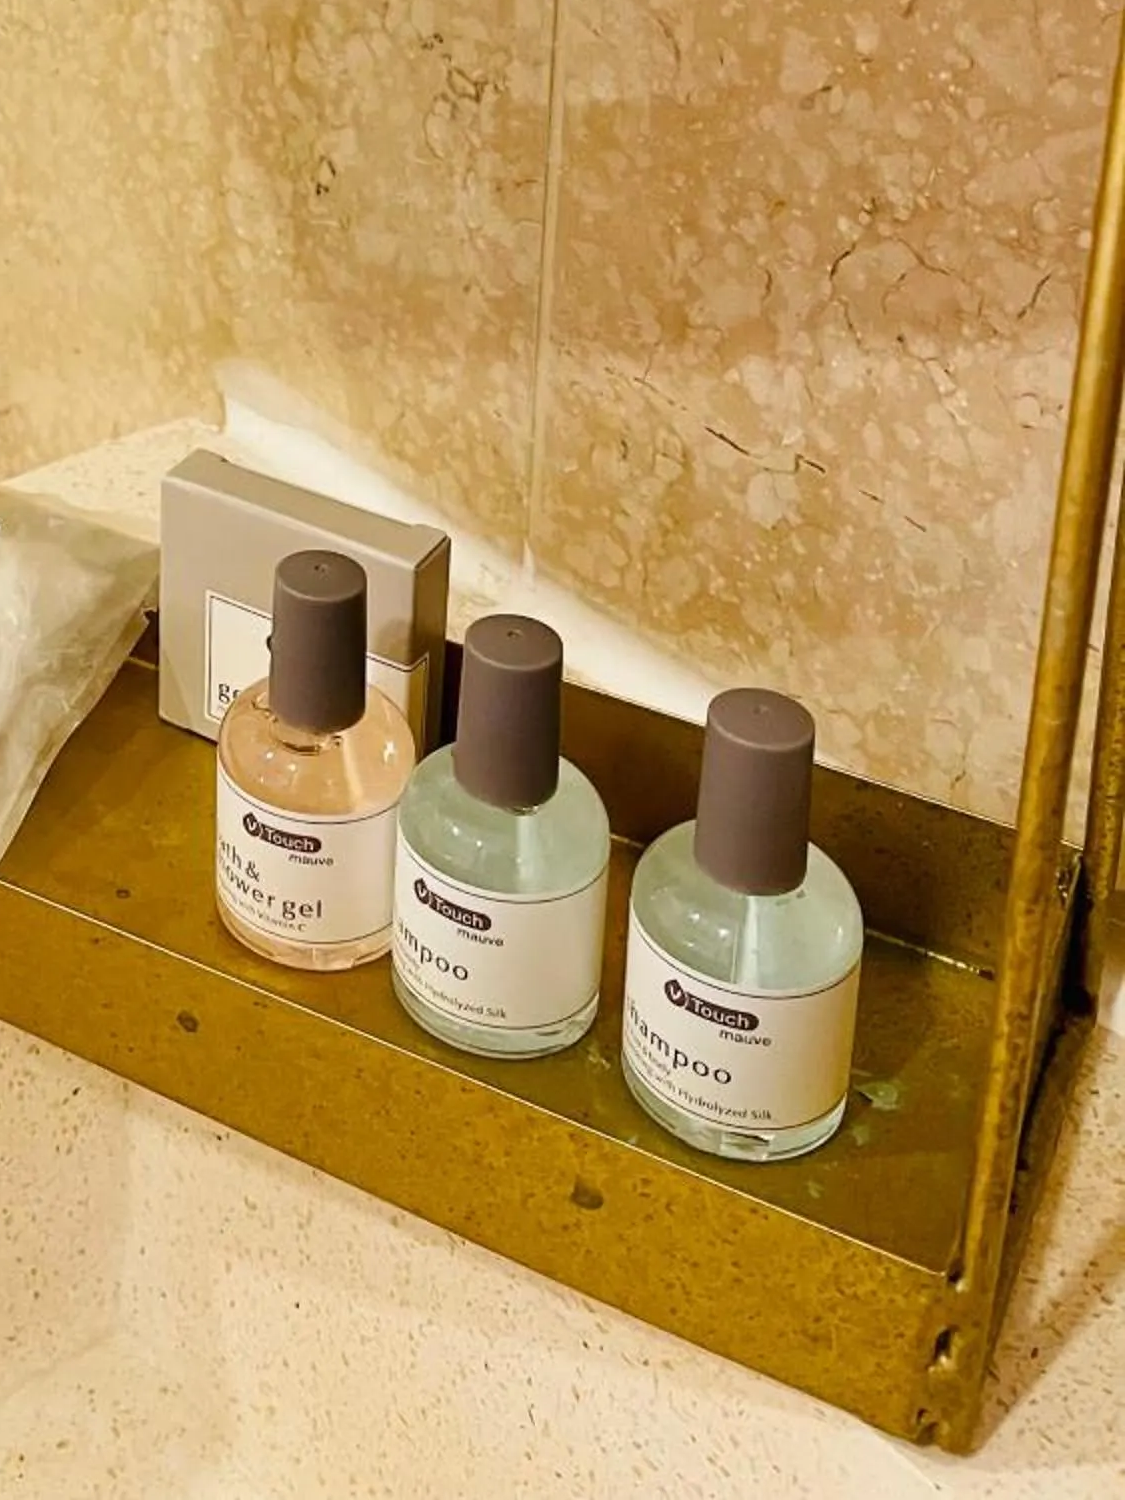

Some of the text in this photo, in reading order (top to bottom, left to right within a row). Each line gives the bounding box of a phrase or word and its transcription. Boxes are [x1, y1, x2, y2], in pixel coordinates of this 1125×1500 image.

[265, 828, 315, 852] Touch
[287, 853, 335, 867] mauve
[245, 860, 260, 883] &
[282, 899, 323, 921] gel
[435, 897, 485, 929] Touch
[457, 927, 505, 947] mauve
[693, 999, 751, 1031] Touch
[719, 1028, 773, 1048] mauve
[750, 1108, 773, 1120] Silk
